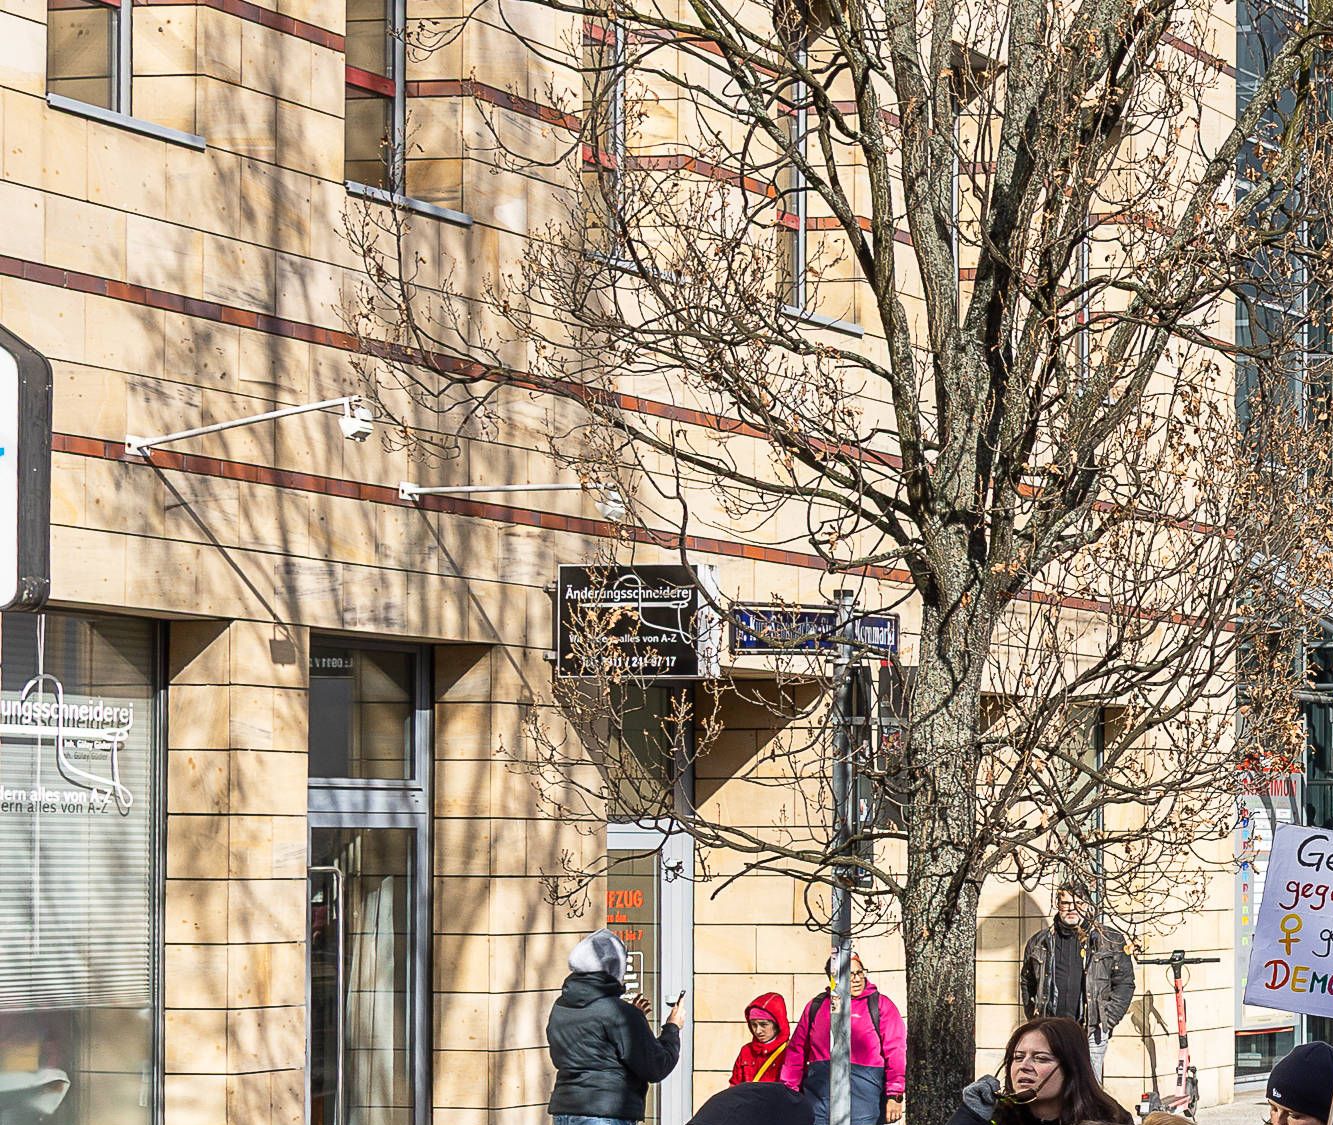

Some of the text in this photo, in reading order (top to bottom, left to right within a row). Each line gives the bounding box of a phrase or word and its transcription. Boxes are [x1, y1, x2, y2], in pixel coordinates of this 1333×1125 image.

[643, 635, 658, 643] von
[661, 634, 677, 643] A-Z
[30, 785, 60, 802] alles
[64, 791, 87, 802] von
